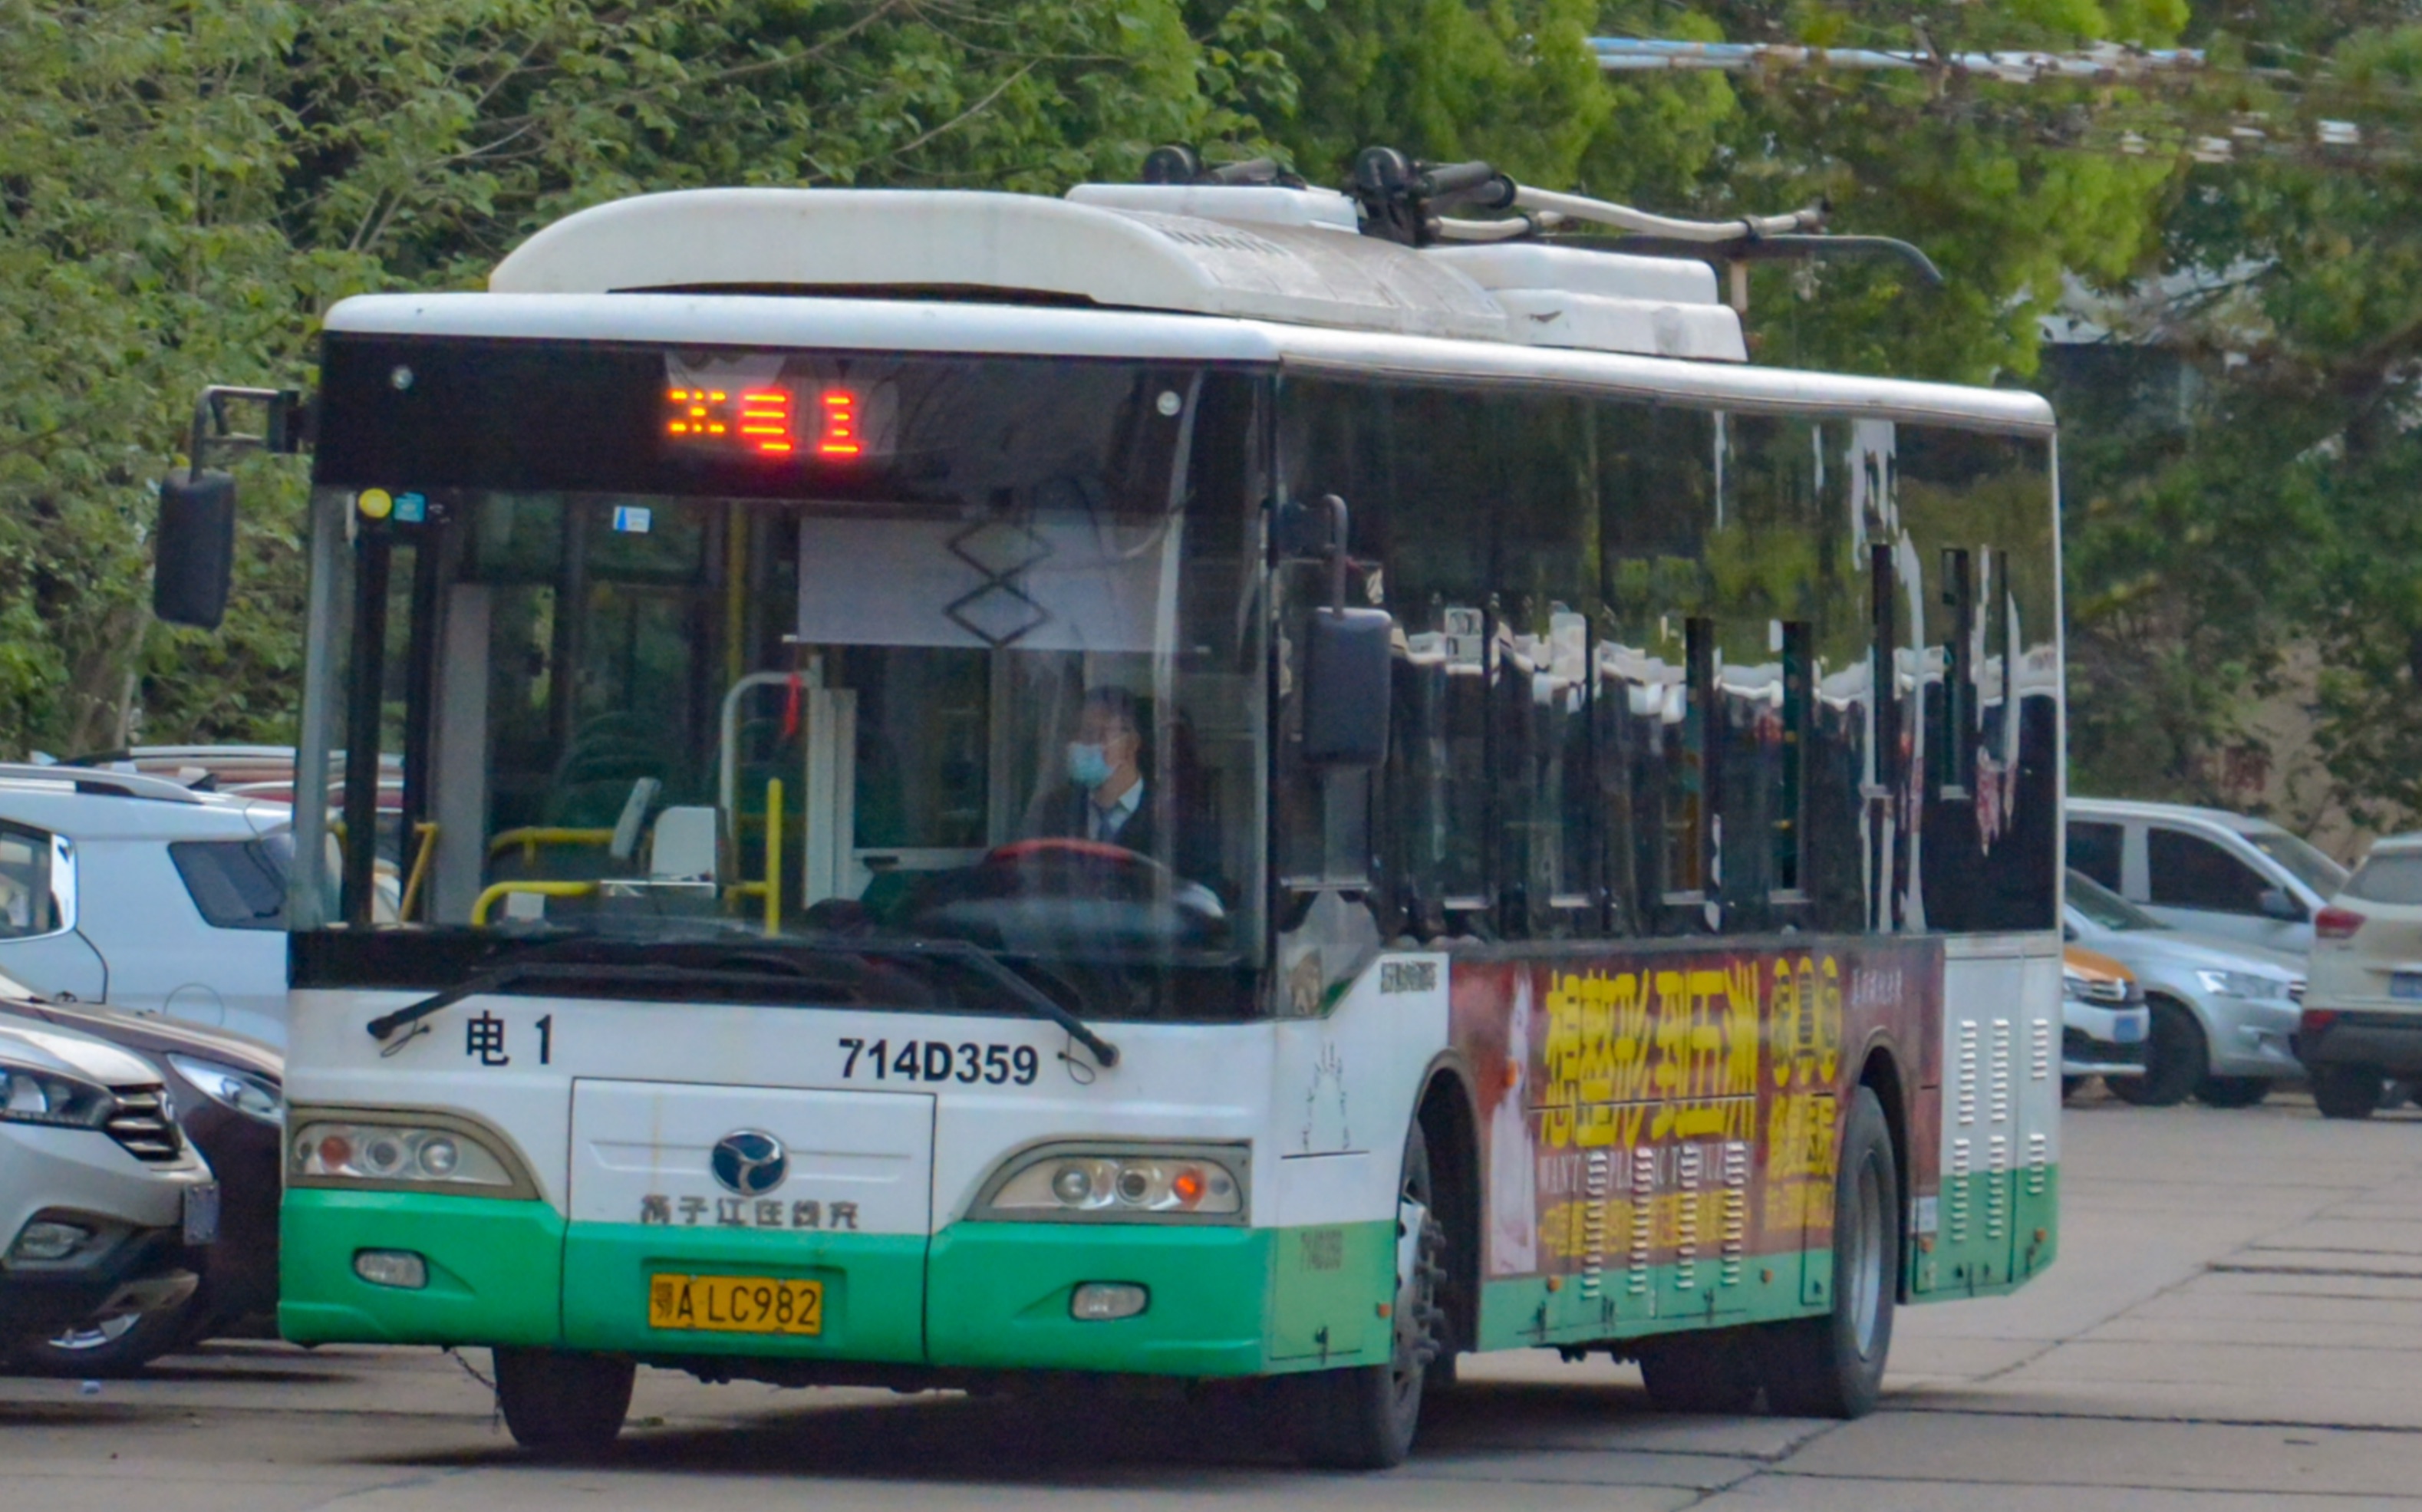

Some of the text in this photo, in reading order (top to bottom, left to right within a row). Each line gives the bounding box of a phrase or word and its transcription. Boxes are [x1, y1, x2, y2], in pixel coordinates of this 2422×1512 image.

[466, 1010, 552, 1066] 电 1
[838, 1037, 1040, 1086] 714D359
